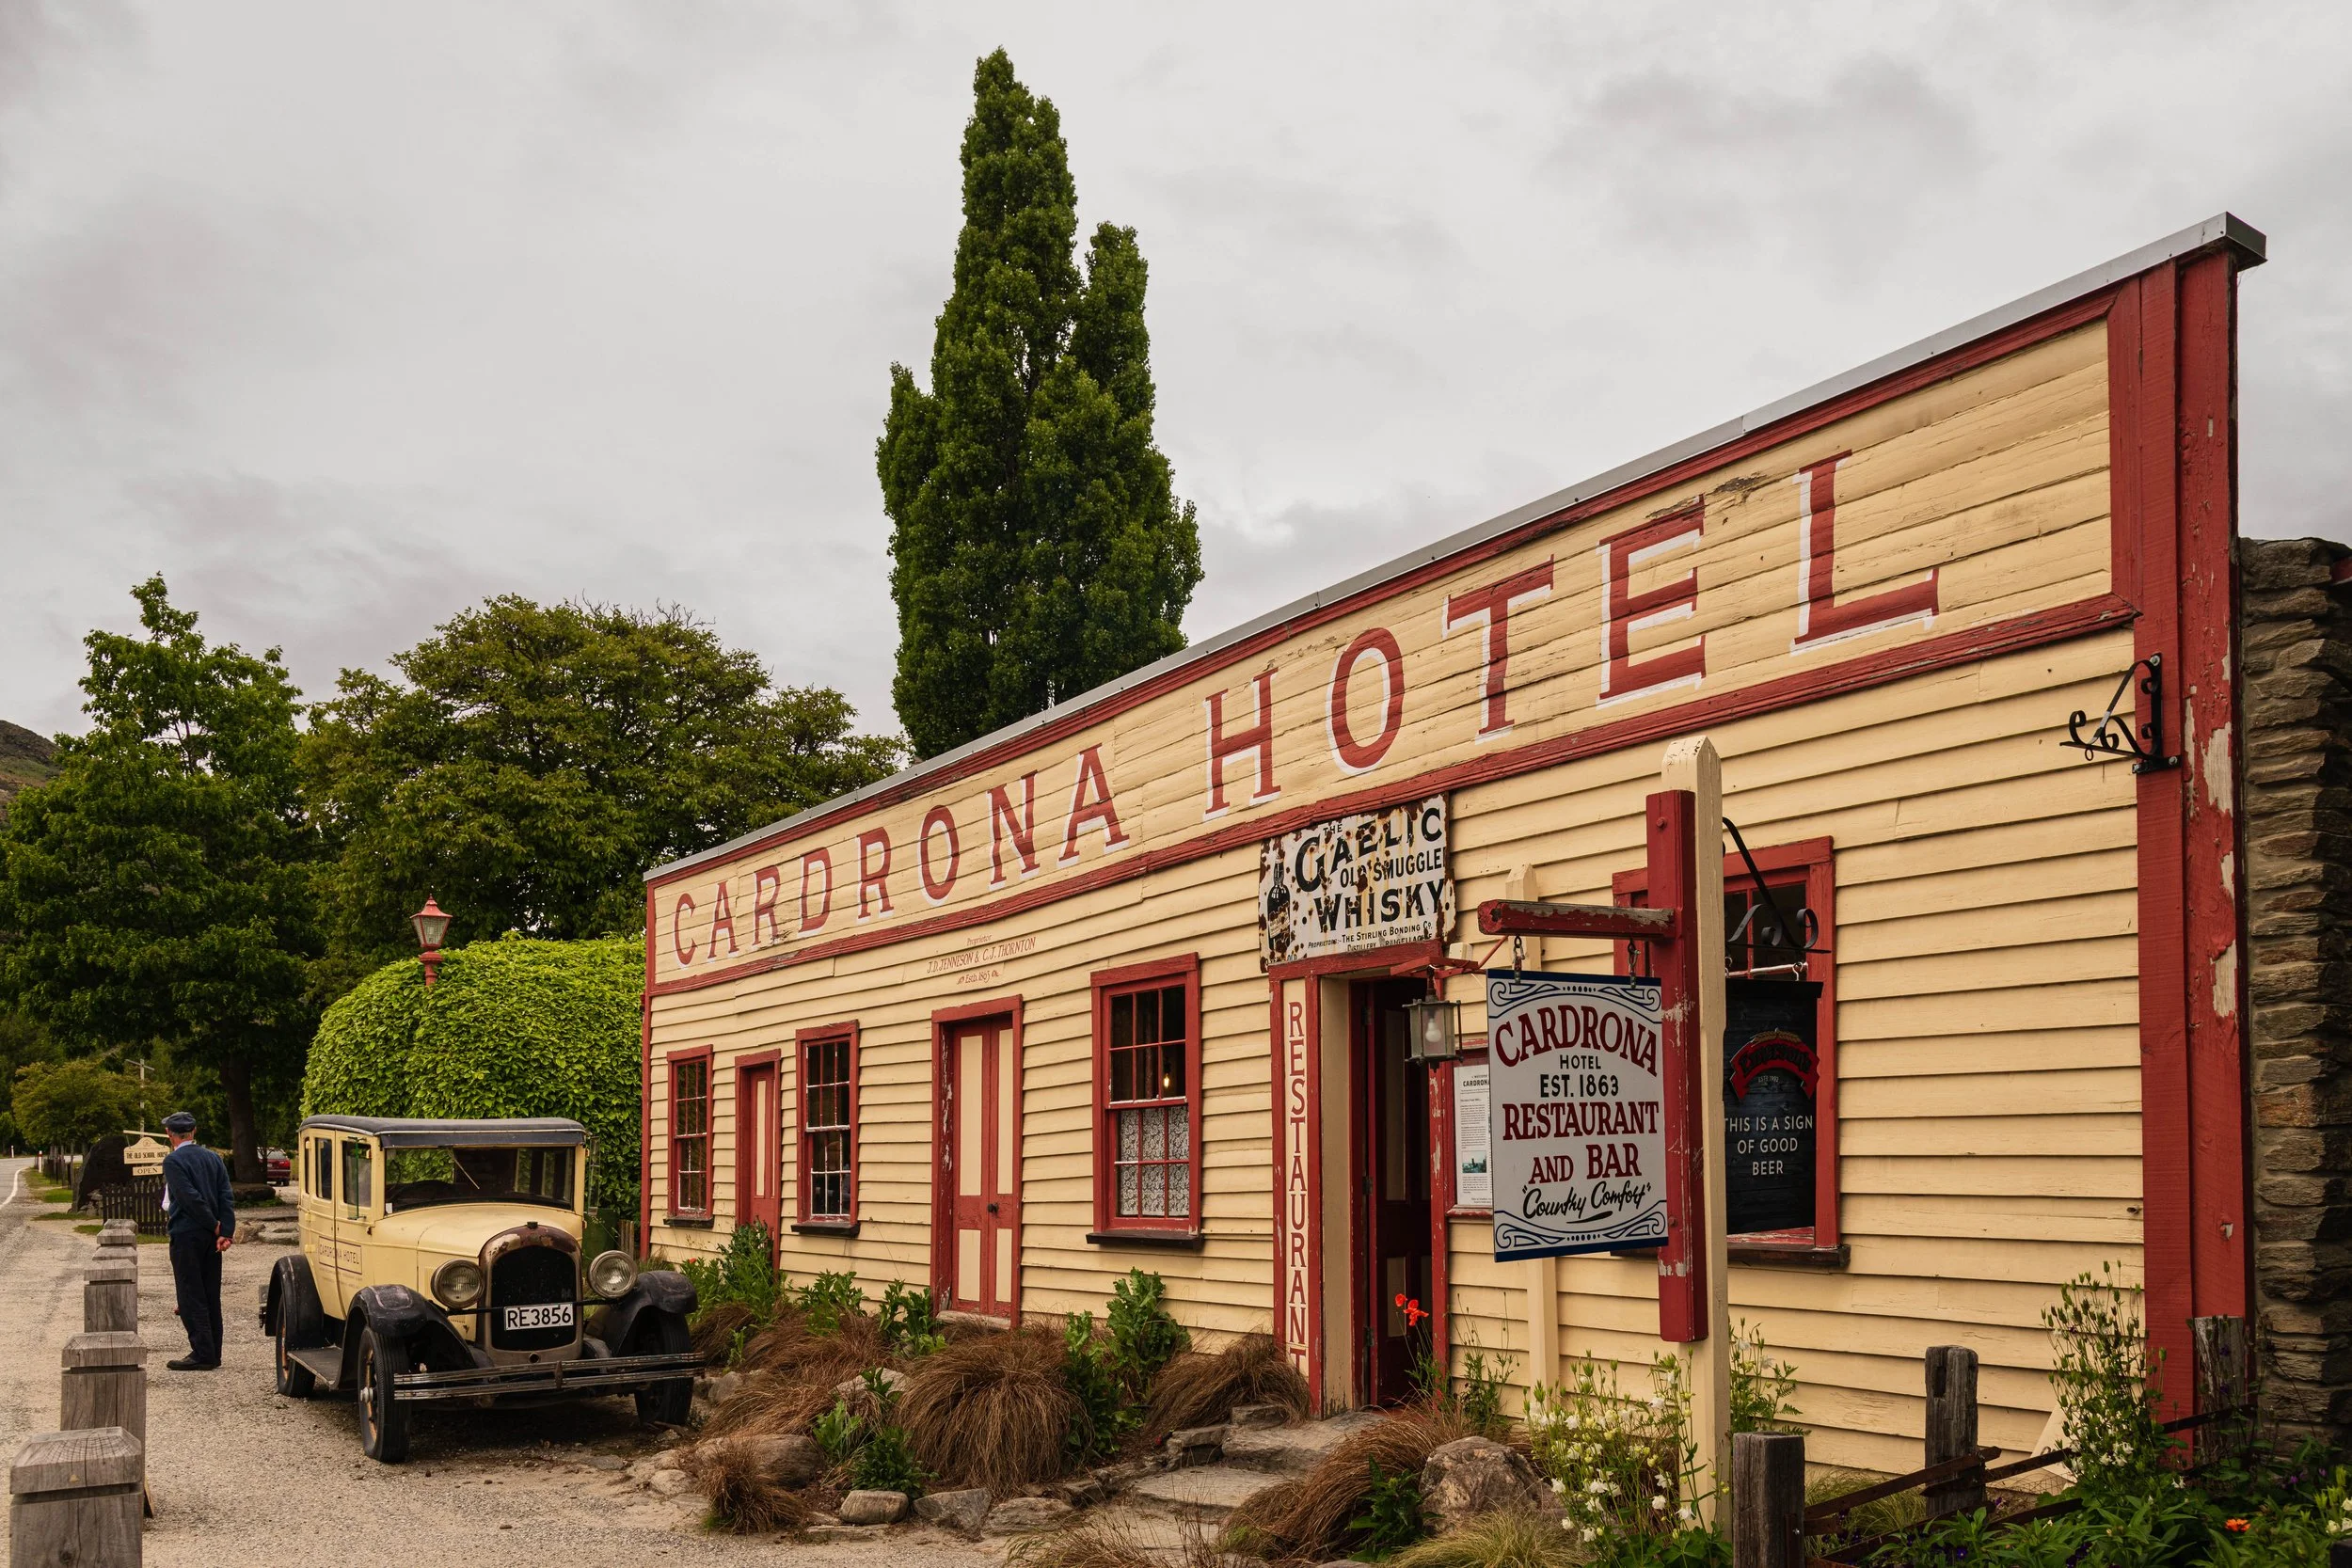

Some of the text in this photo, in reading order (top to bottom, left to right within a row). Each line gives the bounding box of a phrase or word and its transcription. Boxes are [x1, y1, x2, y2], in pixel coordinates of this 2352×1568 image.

[674, 450, 1940, 967] CARDRONA HOTEL
[1323, 823, 1343, 836] THE
[1295, 807, 1442, 893] GAELIC
[1374, 847, 1445, 882] SMUGGLE
[1314, 878, 1444, 933] WHISKY
[1342, 934, 1355, 943] THE
[1357, 928, 1388, 941] STIRLING
[1389, 924, 1421, 936] BONDING
[997, 937, 1037, 958] THORNTON
[1495, 1005, 1658, 1077] CARDRONA
[1560, 1054, 1601, 1070] HOTEL
[1463, 1079, 1488, 1087] CARDRON
[1540, 1074, 1619, 1098] EST. 1863
[1502, 1101, 1659, 1140] RESTAURANT
[1756, 1117, 1767, 1132] IS
[1771, 1117, 1780, 1131] A
[1785, 1116, 1814, 1130] SIGN
[1738, 1138, 1799, 1154] OF GOOD
[1528, 1155, 1574, 1185] AND
[1586, 1143, 1643, 1180] BAR
[1752, 1161, 1784, 1176] BEER
[1288, 1001, 1307, 1370] RESTAURANT
[343, 1249, 359, 1264] HOTEL
[507, 1306, 572, 1328] RE3856
